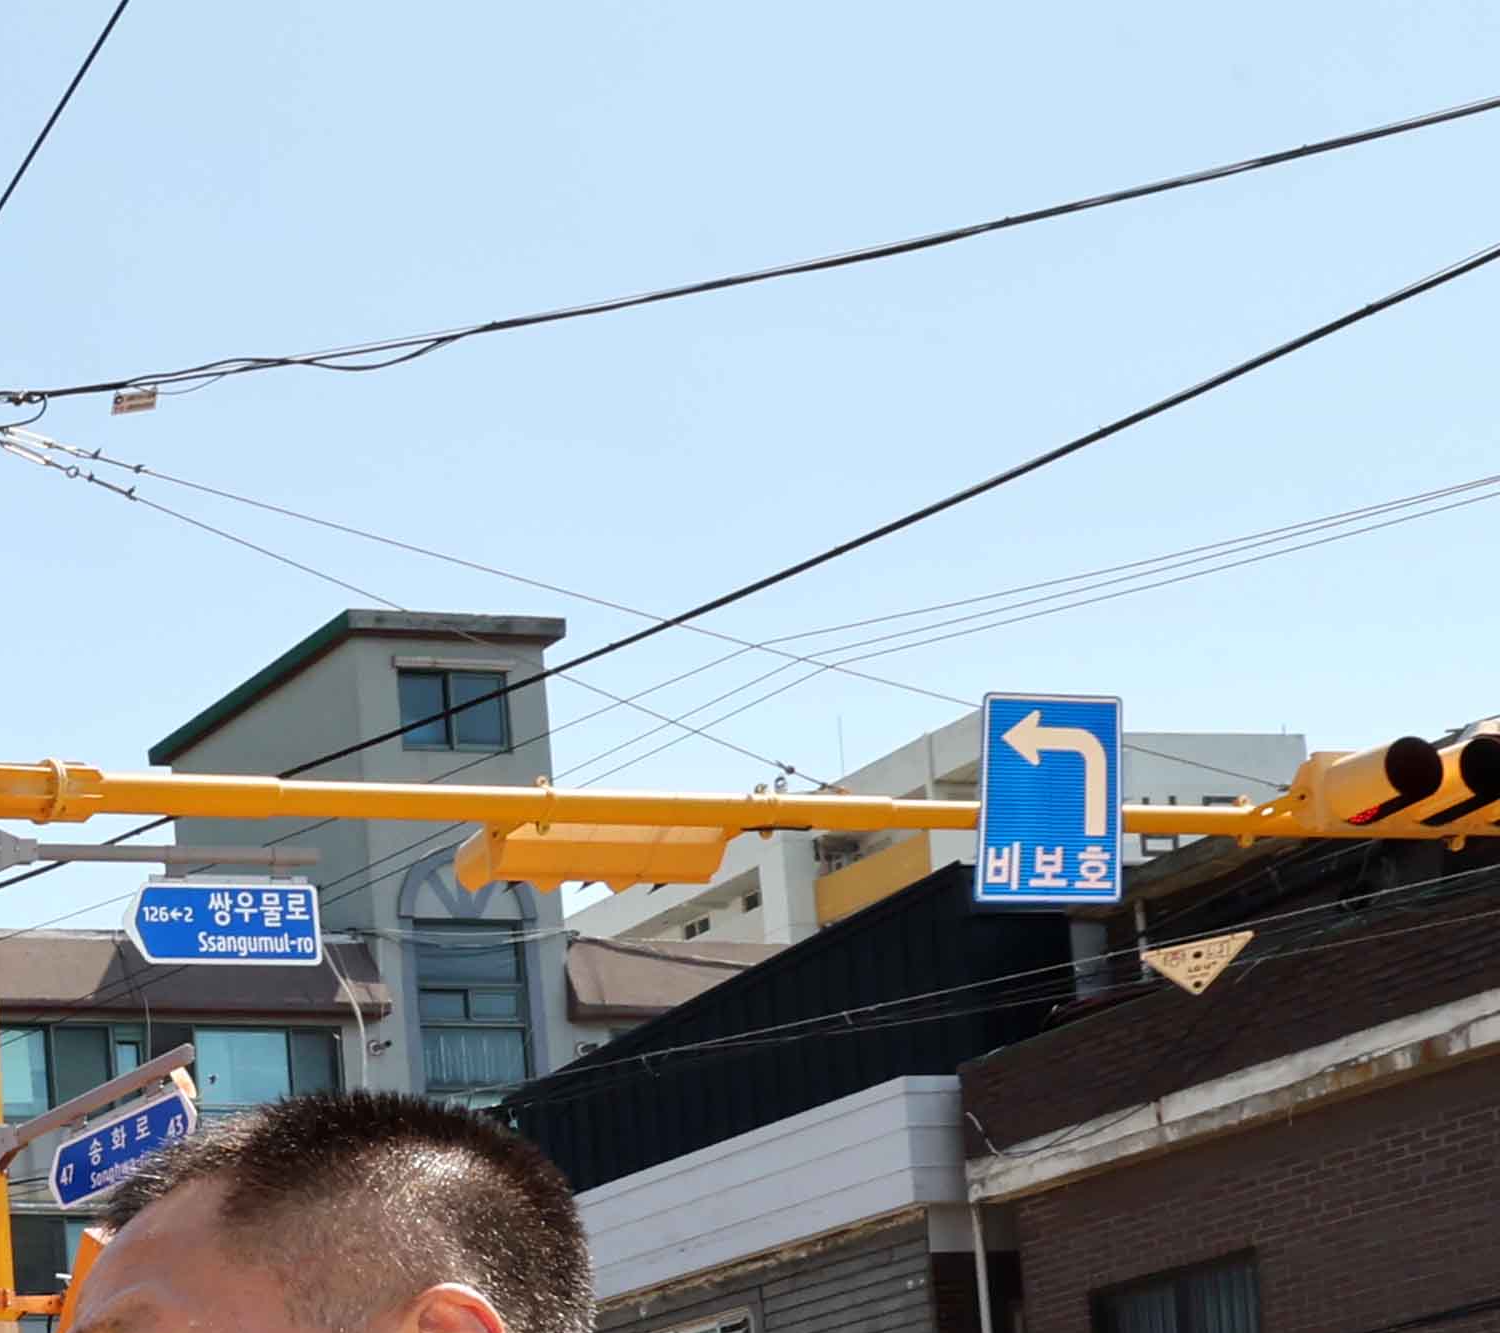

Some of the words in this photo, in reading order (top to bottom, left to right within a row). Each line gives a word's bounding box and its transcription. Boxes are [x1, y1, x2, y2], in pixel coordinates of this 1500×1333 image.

[986, 841, 1113, 891] 비보호
[208, 891, 310, 928] 쌍우물로
[198, 931, 314, 957] Ssangumul-ro
[59, 1163, 74, 1186] 47
[88, 1115, 152, 1166] 송화로
[167, 1114, 185, 1138] 43
